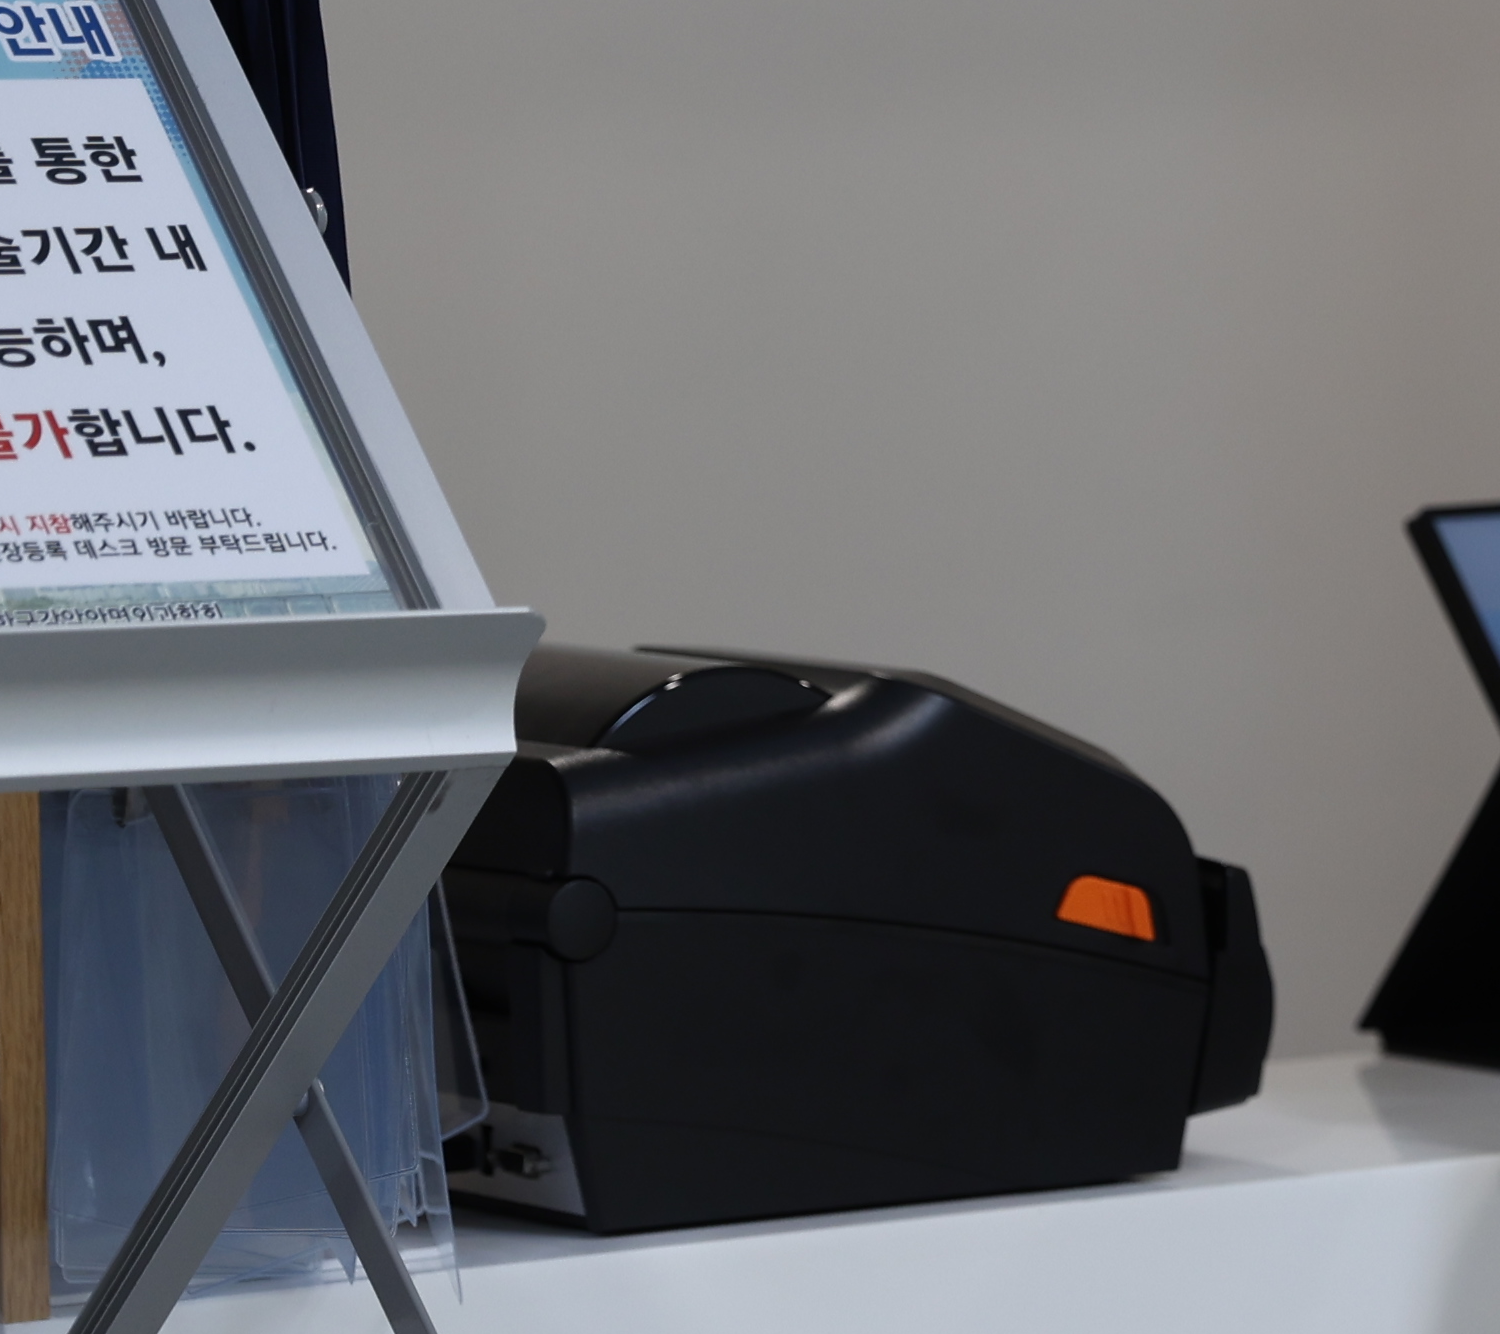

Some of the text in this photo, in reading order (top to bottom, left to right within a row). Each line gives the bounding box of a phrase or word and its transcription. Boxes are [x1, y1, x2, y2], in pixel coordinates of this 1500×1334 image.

[34, 136, 144, 184] 통한
[146, 224, 208, 274] 내
[26, 510, 160, 534] 지참해주시기
[164, 508, 263, 530] 바랍니다.
[73, 538, 142, 560] 데스크
[146, 536, 193, 558] 방문
[197, 531, 338, 556] 부탁드립니다.
